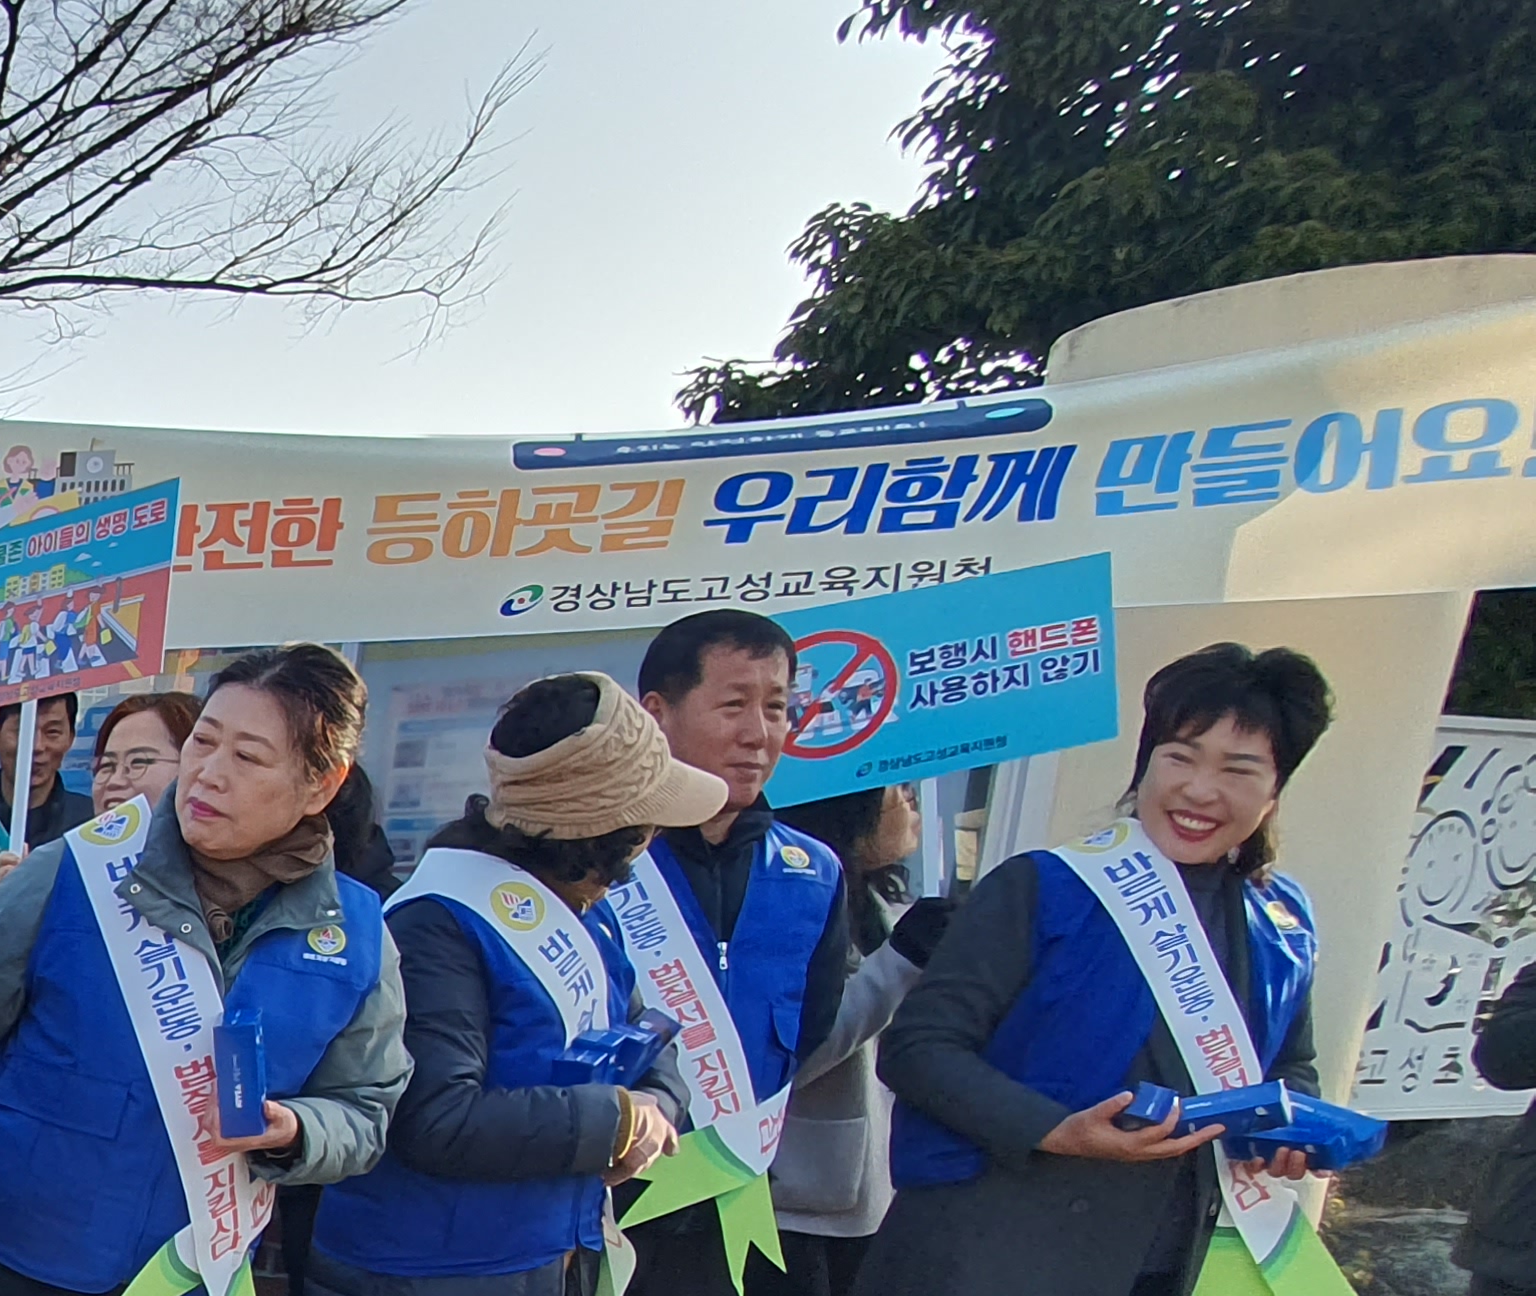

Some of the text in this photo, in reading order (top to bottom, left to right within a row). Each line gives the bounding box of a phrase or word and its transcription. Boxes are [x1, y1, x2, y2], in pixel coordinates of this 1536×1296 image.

[27, 522, 90, 558] 아이들의
[95, 510, 127, 538] 생명
[132, 499, 167, 530] 도로
[366, 478, 685, 566] 등하굣길
[703, 445, 1078, 545] 우리함께
[550, 556, 993, 613] 경상남도고성교육지원청
[908, 617, 1101, 677] 보행시 핸드폰
[908, 648, 1101, 711] 사용하지 않기
[1103, 851, 1177, 927] 바르게
[538, 928, 595, 1007] 바르게
[204, 1163, 242, 1262] 지킵시다
